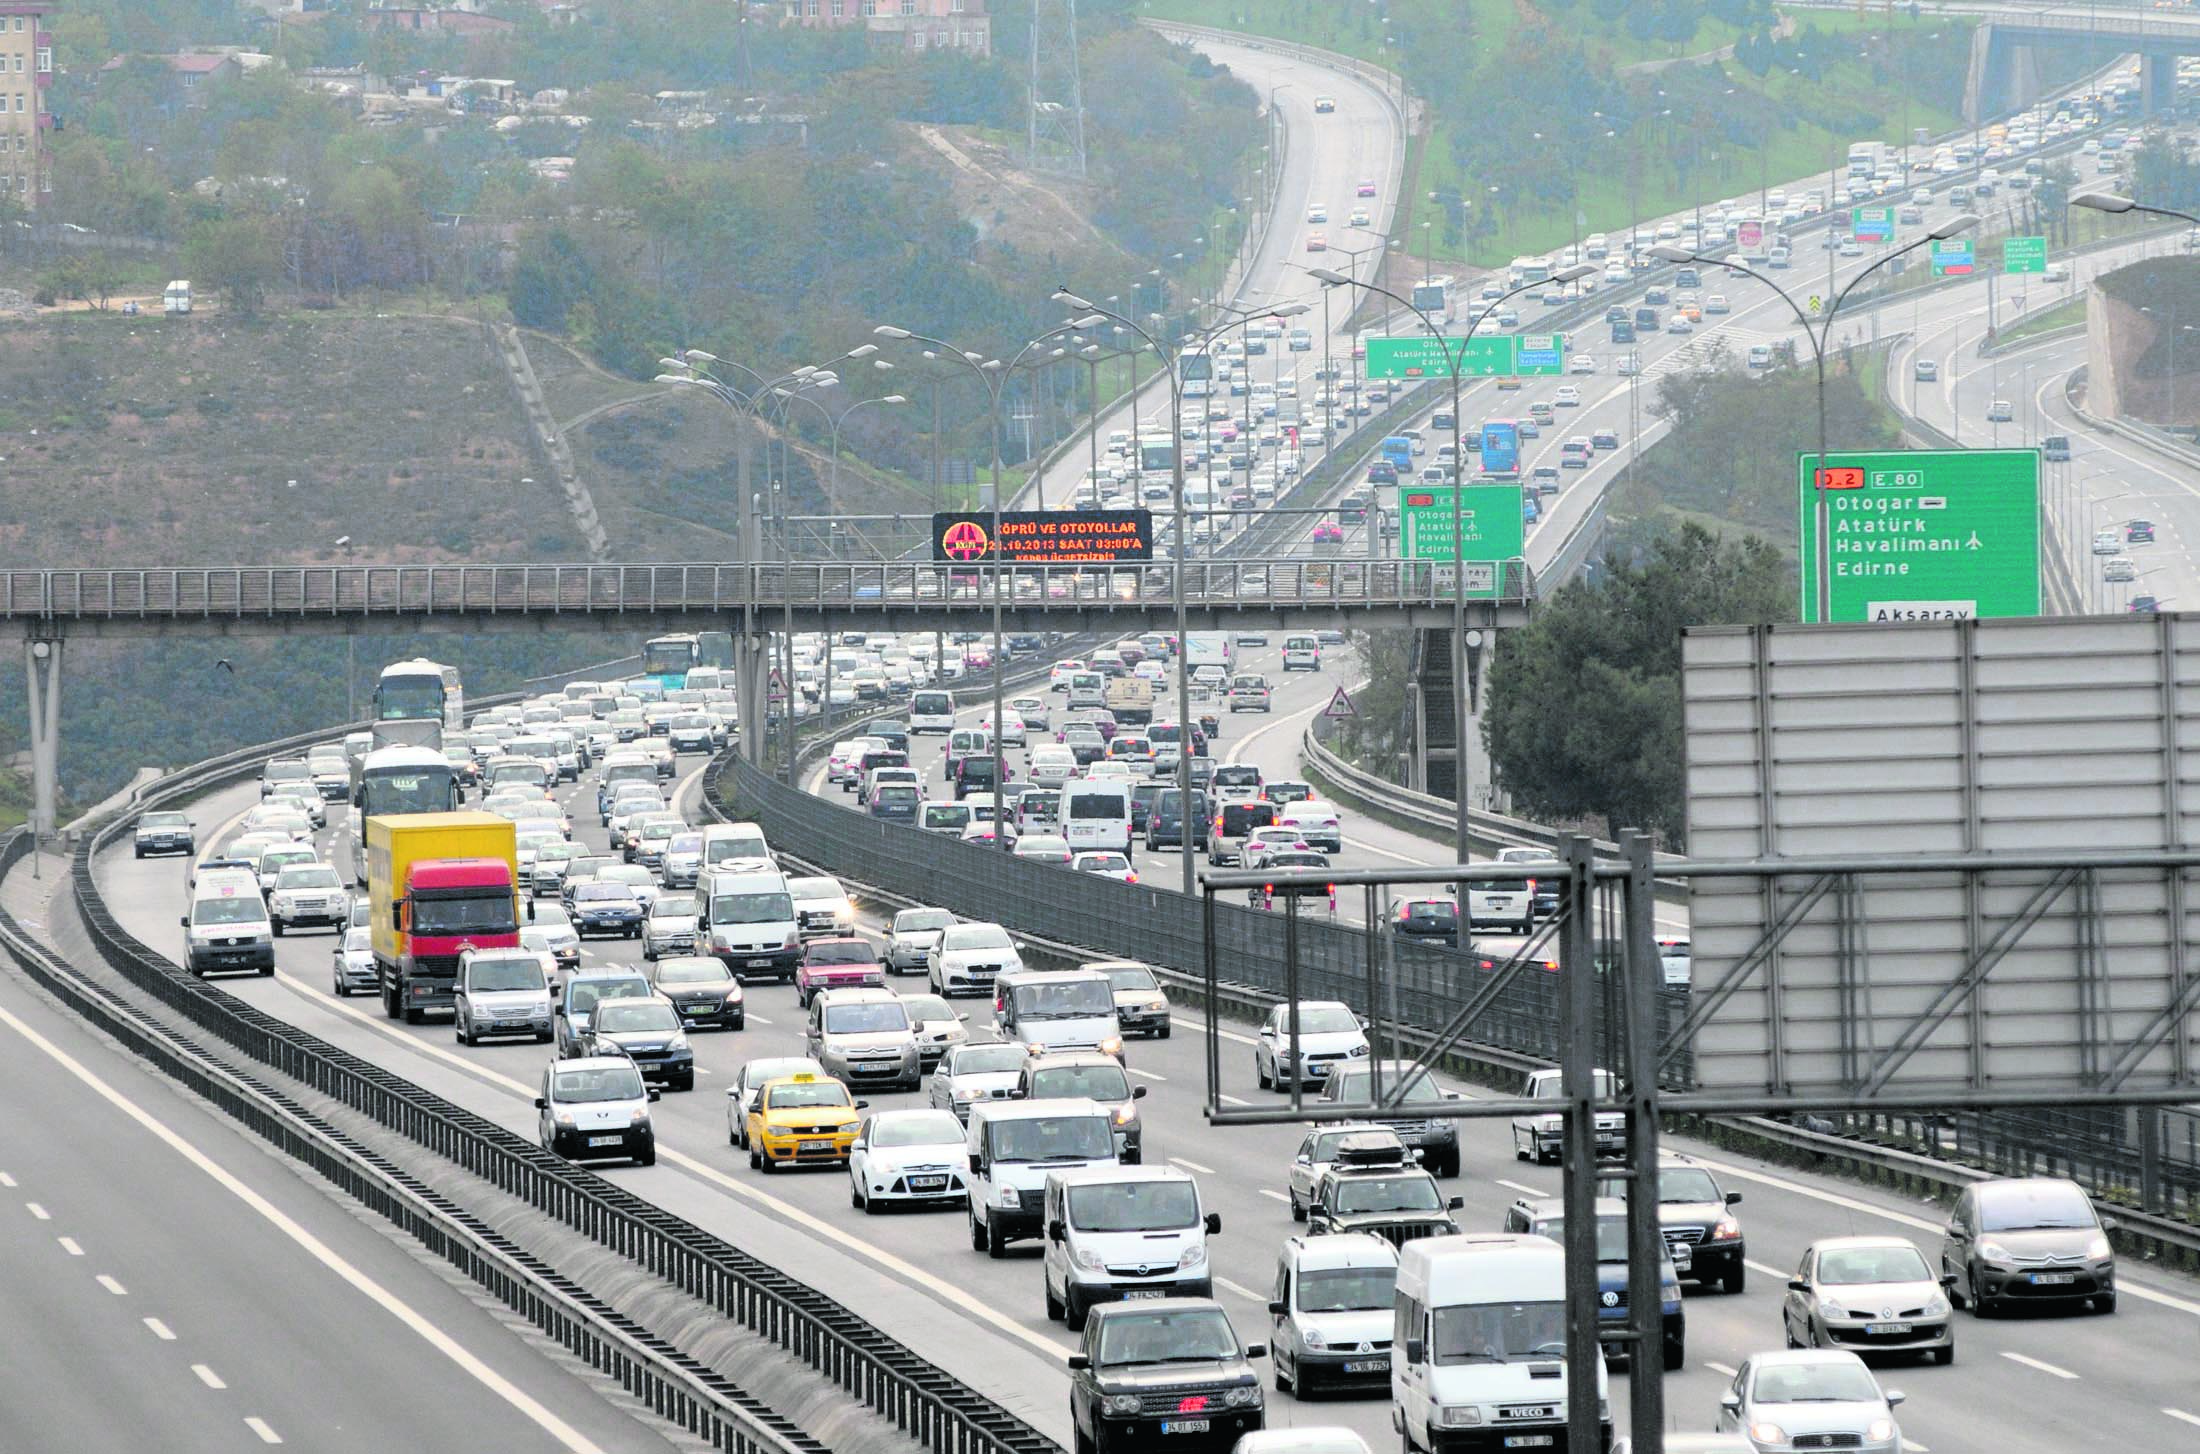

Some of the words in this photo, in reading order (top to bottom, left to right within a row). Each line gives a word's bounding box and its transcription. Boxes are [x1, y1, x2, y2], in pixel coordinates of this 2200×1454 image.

[1836, 496, 1913, 514] Otogar
[1418, 511, 1457, 520] Otoga
[1040, 523, 1057, 534] VE
[1060, 522, 1136, 533] OTOYOLLAR
[1837, 517, 1926, 533] Atatürk
[1059, 539, 1092, 550] SAAT
[1836, 537, 1960, 553] Havalimanı
[1837, 561, 1909, 576] Edirne
[1876, 609, 1968, 622] Aksaray
[1509, 1408, 1544, 1417] IVECO
